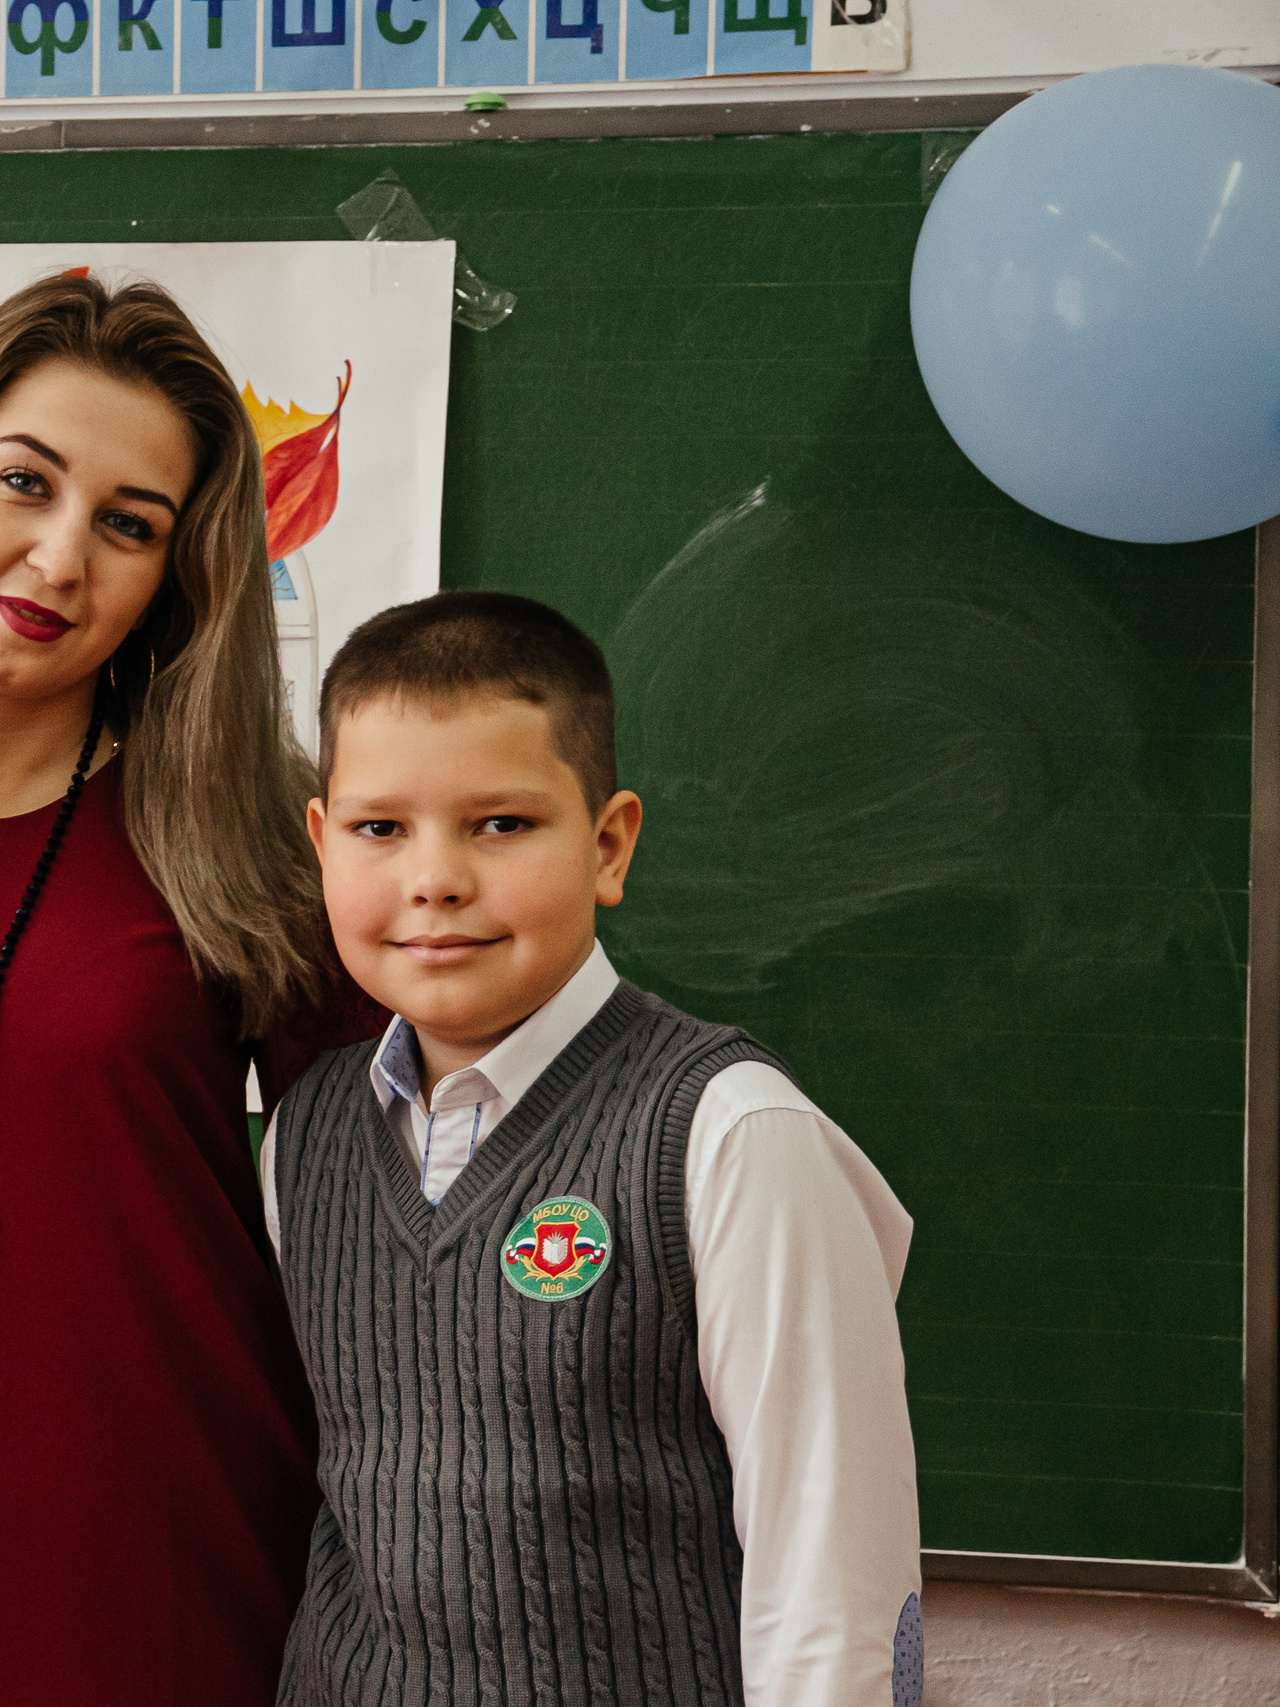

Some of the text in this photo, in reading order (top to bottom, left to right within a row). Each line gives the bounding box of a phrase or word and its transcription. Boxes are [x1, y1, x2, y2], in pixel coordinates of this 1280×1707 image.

[7, 0, 89, 76] ф
[118, 0, 163, 51] к
[271, 0, 346, 47] ш
[375, 0, 427, 45] с
[546, 0, 603, 54] ц
[532, 1203, 591, 1224] МБОУ ЦО
[540, 1282, 564, 1295] №6
